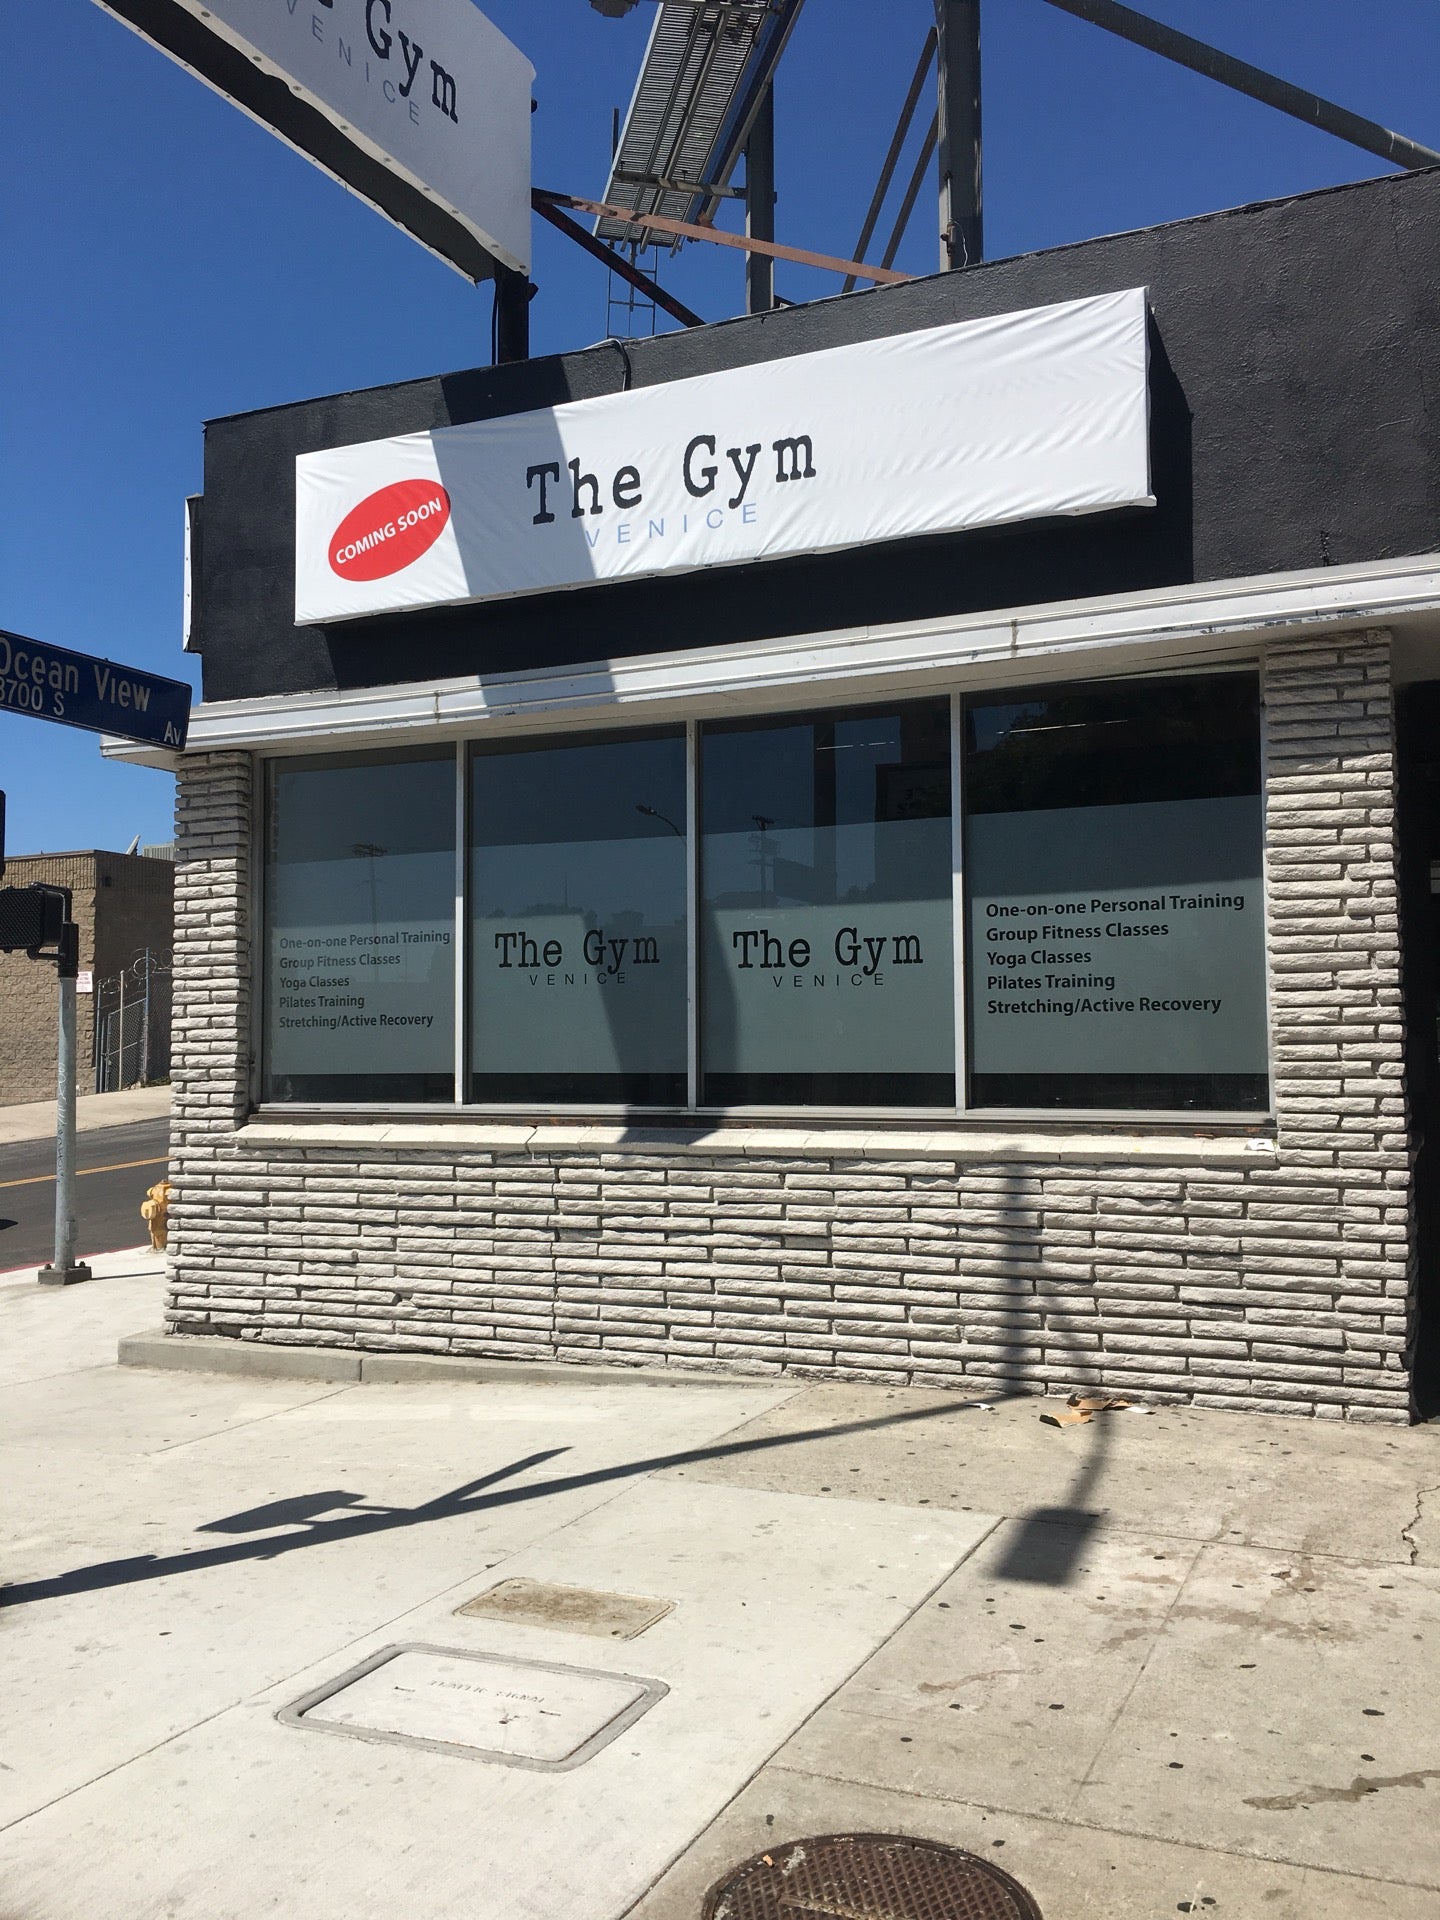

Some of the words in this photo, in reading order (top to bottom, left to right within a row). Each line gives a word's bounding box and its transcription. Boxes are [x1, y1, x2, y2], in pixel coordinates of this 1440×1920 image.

[366, 0, 459, 124] Gym
[526, 457, 643, 525] The
[683, 434, 817, 509] Gym
[336, 523, 396, 564] COMING
[397, 498, 442, 532] SOON
[584, 502, 758, 549] VENICE
[0, 637, 79, 694] Ocean
[94, 664, 151, 712] View
[53, 690, 65, 716] S
[985, 901, 1088, 918] One-on-one
[1091, 896, 1167, 914] Personal
[1169, 892, 1246, 911] Training
[279, 936, 347, 949] One-on-one
[349, 932, 400, 946] Personal
[401, 930, 451, 945] Training
[985, 925, 1038, 946] Group
[1042, 923, 1102, 940] Fitness
[1105, 920, 1170, 939] Classes
[279, 957, 315, 971] Group
[316, 955, 357, 968] Fitness
[359, 953, 401, 966] Classes
[494, 932, 563, 969] The
[583, 929, 661, 975] Gym
[732, 929, 811, 970] The
[834, 926, 924, 975] Gym
[986, 951, 1027, 970] Yoga
[1029, 947, 1092, 966] Classes
[279, 977, 307, 991] Yoga
[308, 975, 351, 988] Classes
[529, 971, 627, 987] VENICE
[772, 972, 886, 988] VENICE
[986, 973, 1042, 990] Pilates
[1045, 971, 1116, 992] Training
[279, 996, 316, 1009] Pilates
[317, 994, 366, 1009] Training
[987, 996, 1135, 1016] Stretching/Active
[1139, 994, 1222, 1014] Recovery
[279, 1014, 377, 1029] Stretching/Active
[379, 1014, 434, 1028] Recovery
